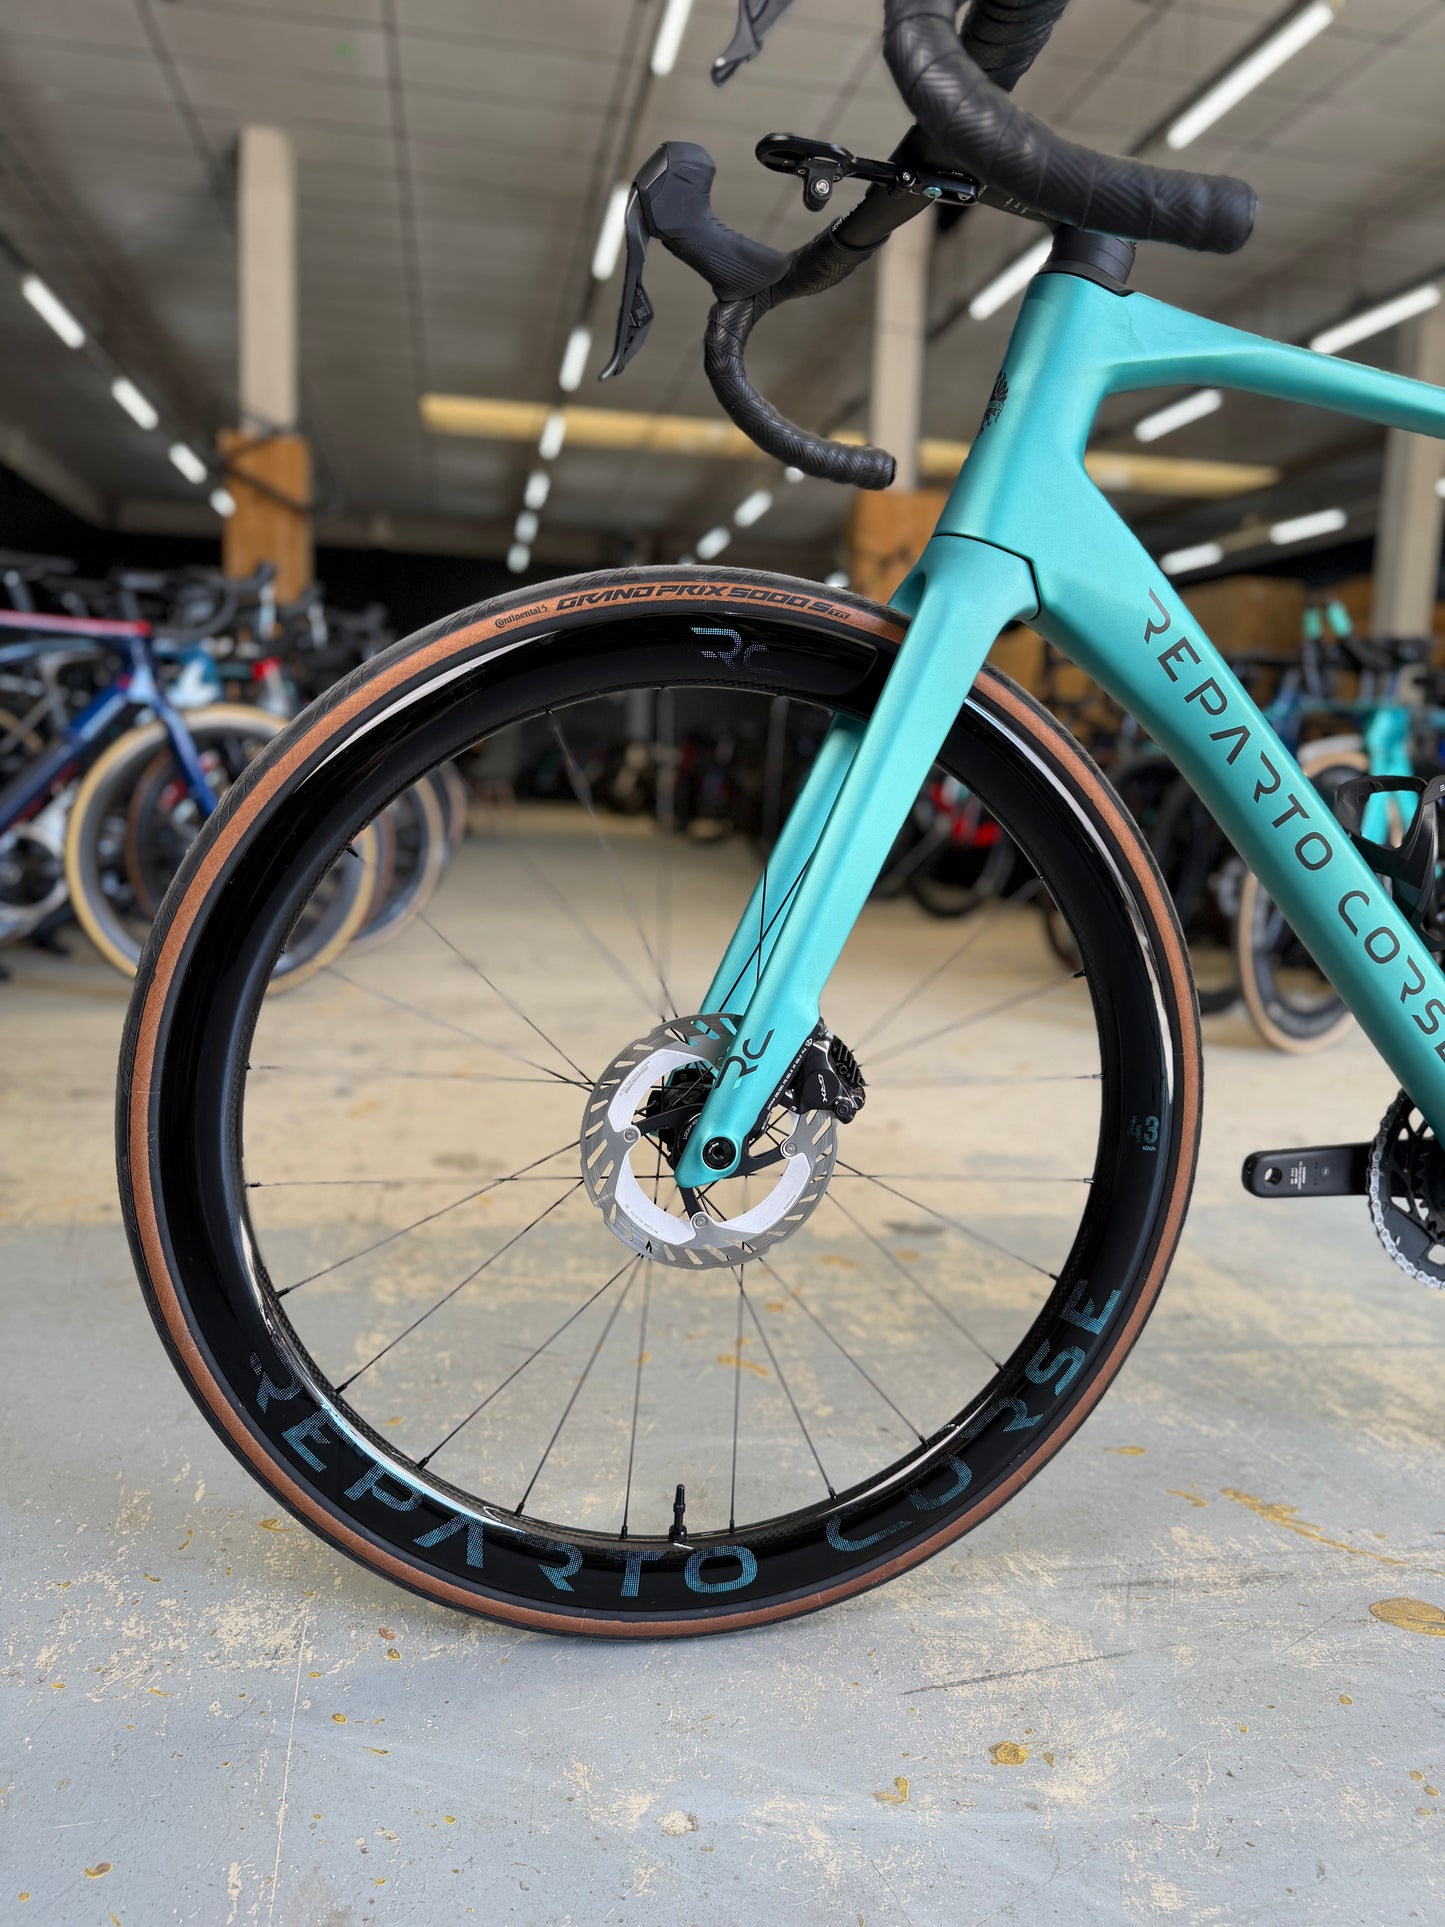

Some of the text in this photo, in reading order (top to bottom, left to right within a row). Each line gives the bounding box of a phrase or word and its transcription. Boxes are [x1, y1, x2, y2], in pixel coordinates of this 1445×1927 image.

[556, 585, 656, 612] GRAND
[655, 584, 728, 597] PRIX
[727, 586, 811, 608] 5000
[494, 606, 542, 629] Continental
[1143, 587, 1333, 871] REPARTO
[817, 1073, 828, 1103] GRX
[249, 1279, 1121, 1597] REPARTO CORSE
